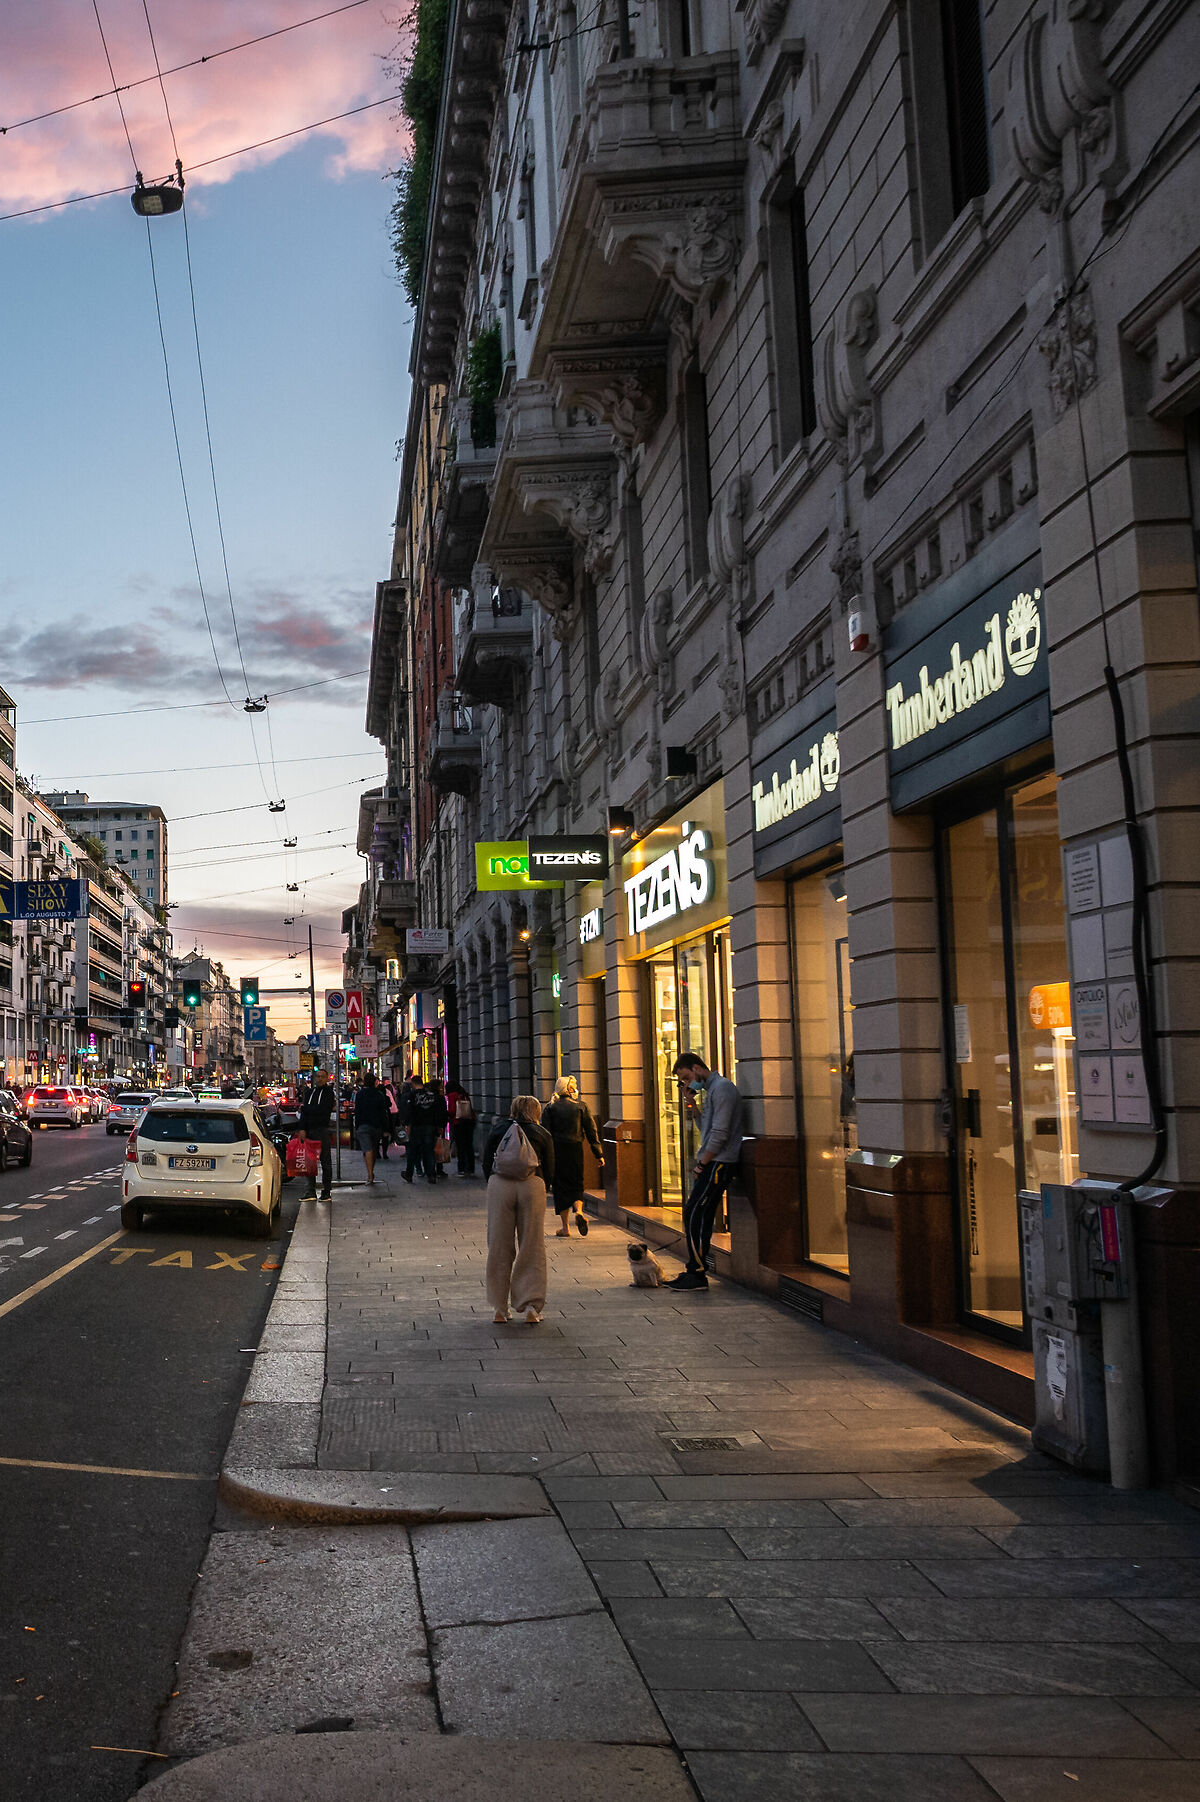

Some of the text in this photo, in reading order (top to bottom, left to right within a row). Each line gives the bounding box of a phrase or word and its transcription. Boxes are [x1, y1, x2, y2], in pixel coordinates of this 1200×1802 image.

[886, 613, 1005, 750] Timberland
[752, 743, 822, 832] Timberland
[28, 883, 68, 898] SEXY
[28, 898, 68, 910] SHOW
[249, 1009, 261, 1025] P
[175, 1158, 184, 1167] FZ
[296, 1148, 306, 1168] SALE
